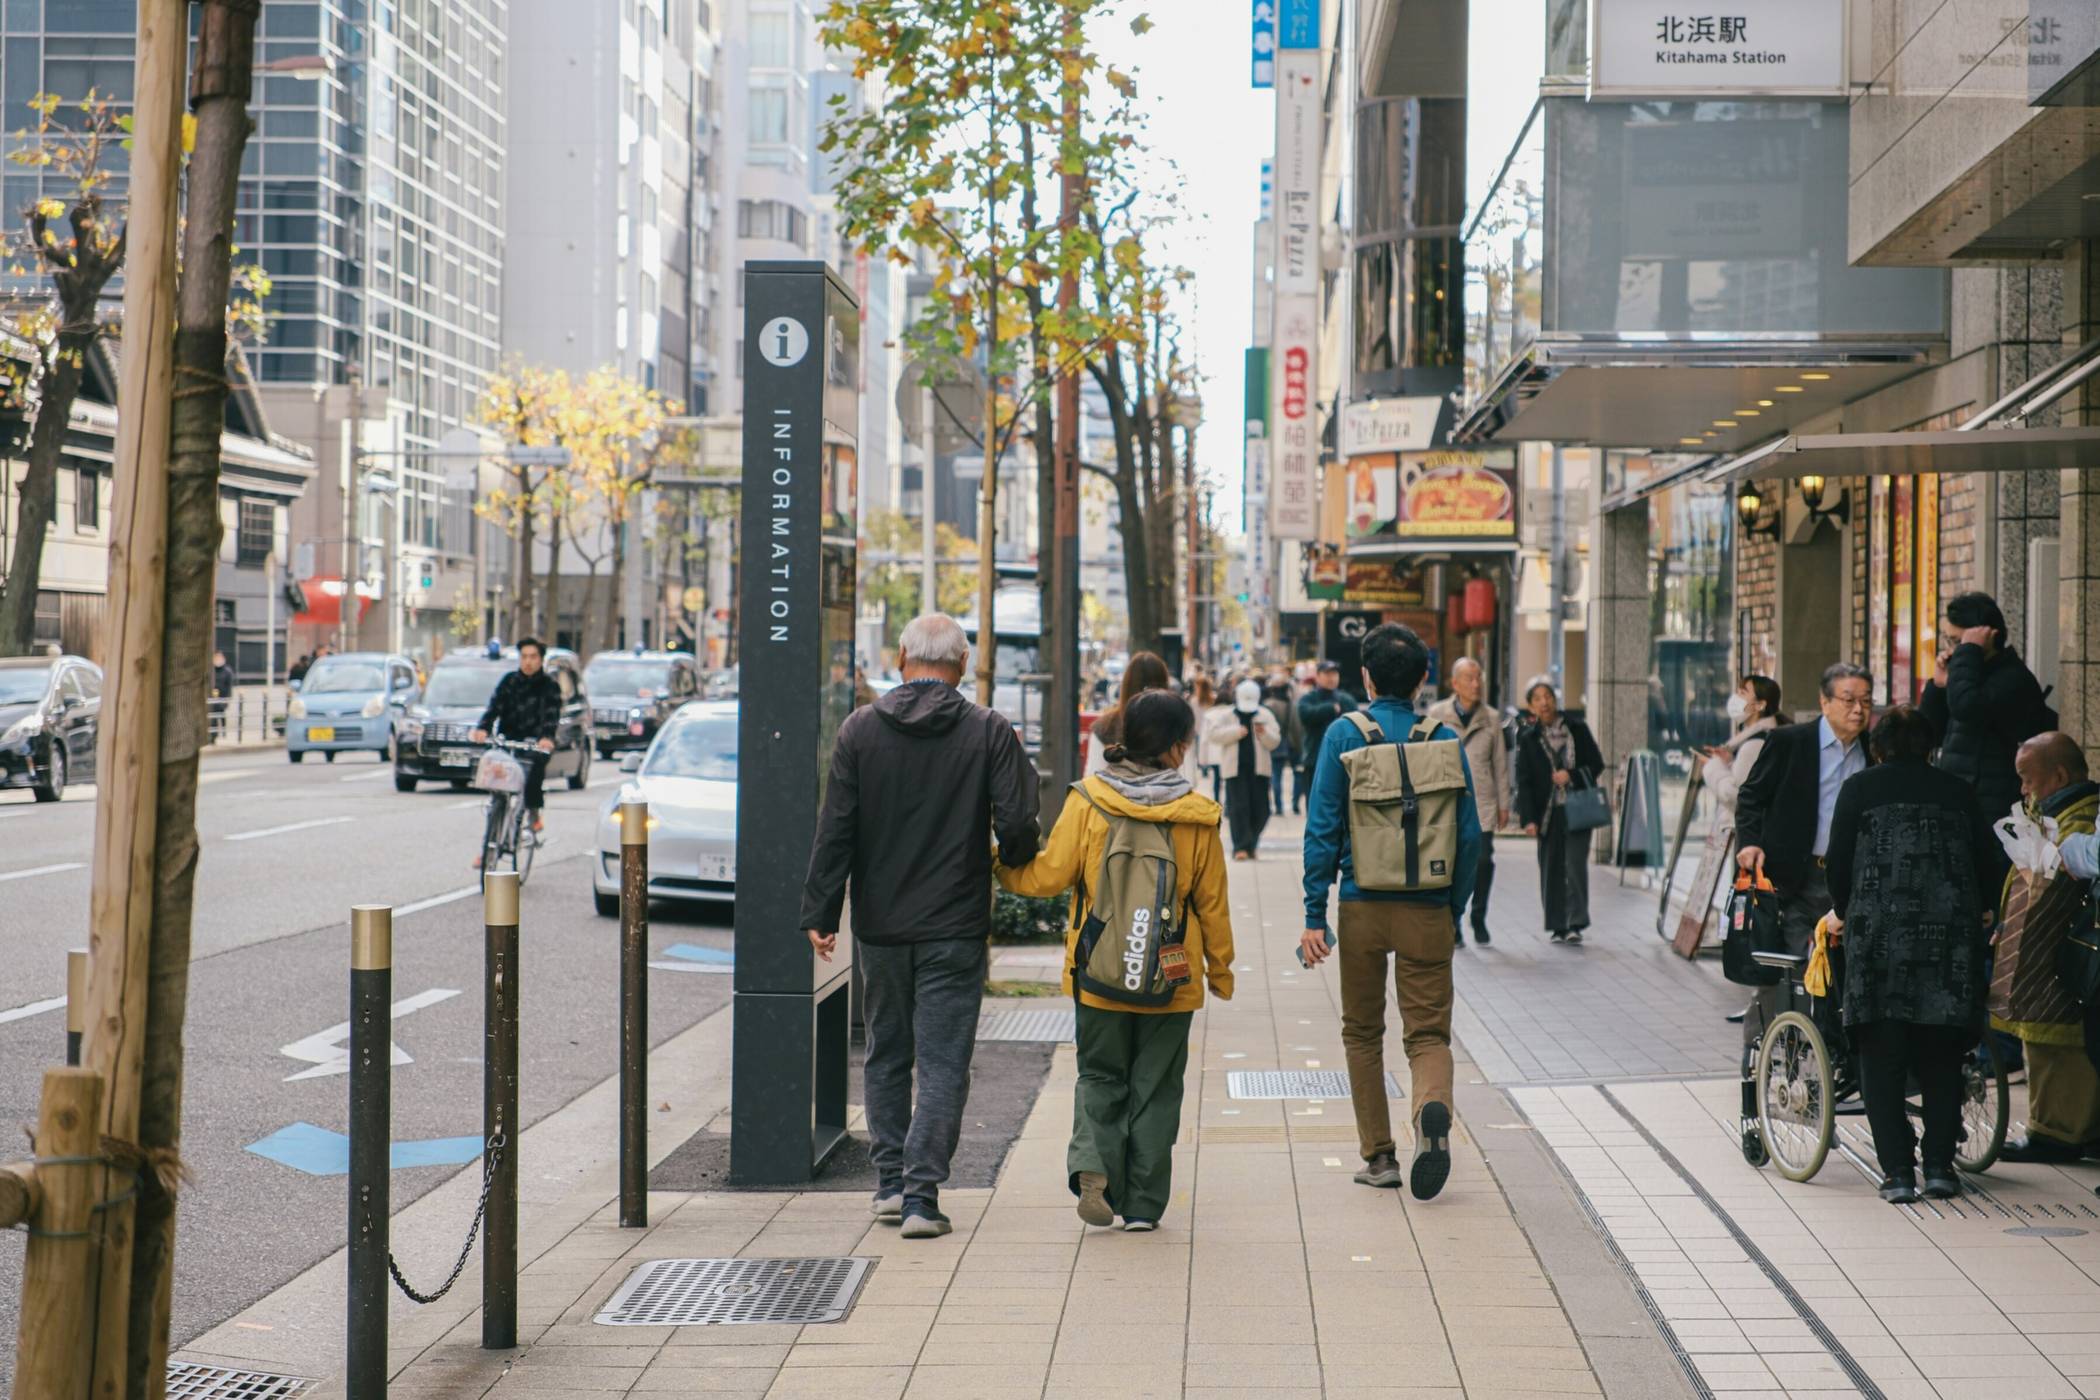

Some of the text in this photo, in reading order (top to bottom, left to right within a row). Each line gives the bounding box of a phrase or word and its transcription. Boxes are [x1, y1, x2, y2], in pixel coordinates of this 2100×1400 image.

[1656, 16, 1747, 44] 北浜駅
[1656, 51, 1787, 64] Kitahama Station
[770, 409, 792, 642] INFORMATION
[1123, 908, 1150, 991] adidas
